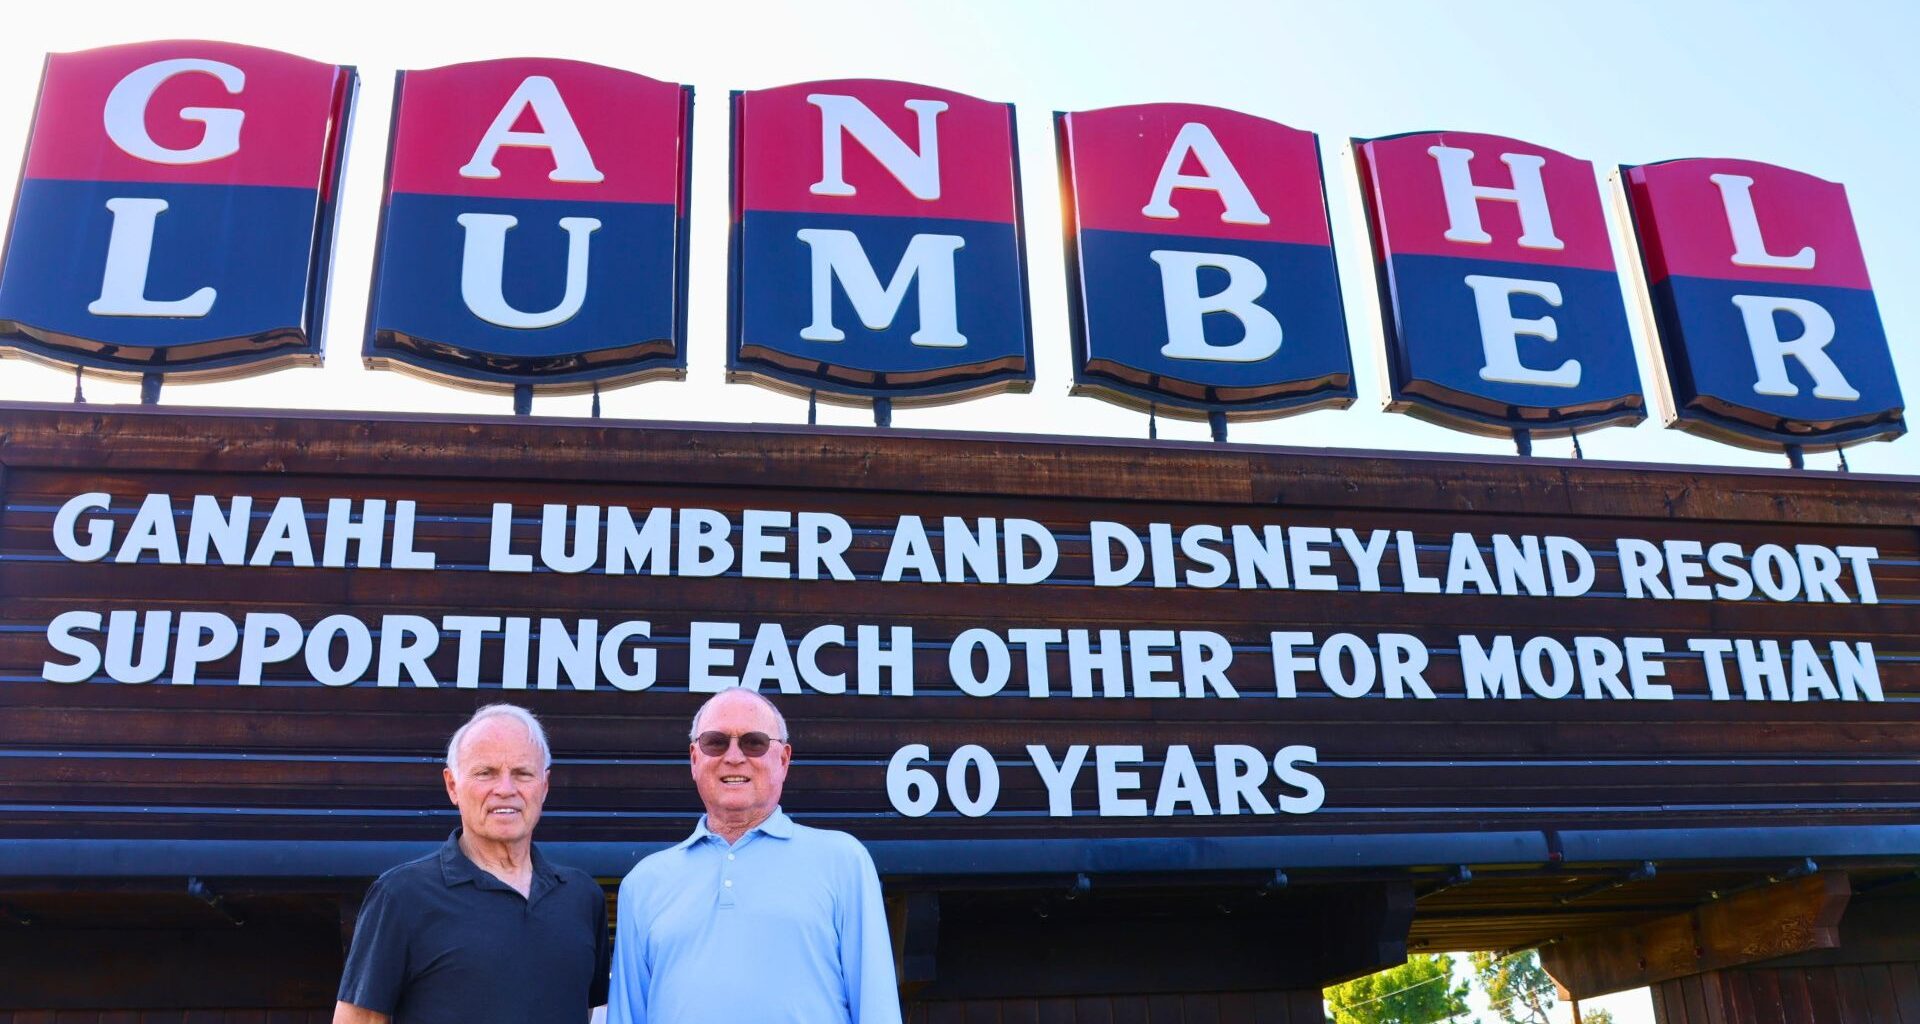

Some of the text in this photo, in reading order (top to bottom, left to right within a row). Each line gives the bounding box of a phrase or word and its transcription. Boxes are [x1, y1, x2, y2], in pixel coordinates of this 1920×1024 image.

[104, 58, 1816, 269] GANAHL
[88, 197, 1860, 400] LUMBER
[53, 492, 1879, 604] GANAHL LUMBER AND DISNEYLAND RESORT
[42, 610, 1885, 702] SUPPORTING EACH OTHER FOR MORE THAN
[886, 743, 1325, 817] 60 YEARS
